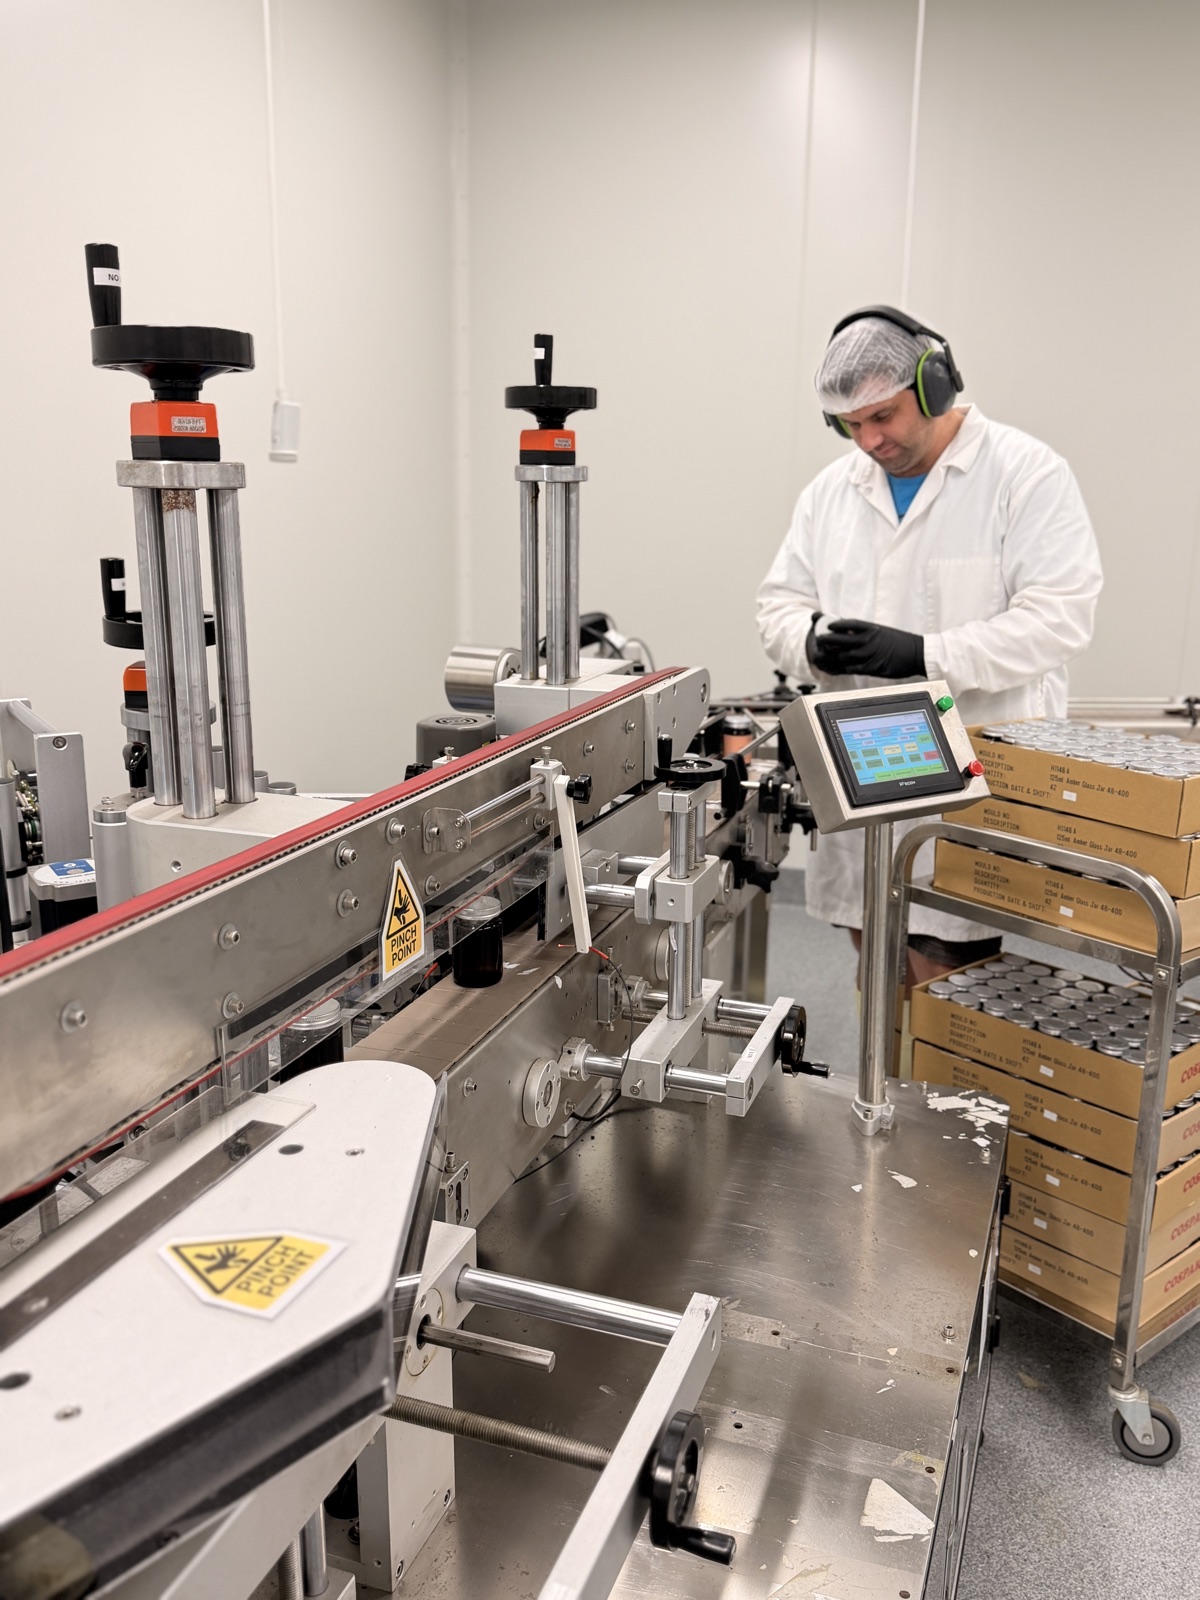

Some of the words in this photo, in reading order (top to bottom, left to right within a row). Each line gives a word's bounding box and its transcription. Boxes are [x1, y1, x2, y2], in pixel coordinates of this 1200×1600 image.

[1011, 784, 1025, 793] DATE
[1066, 778, 1080, 786] Amber
[1082, 781, 1095, 790] Glass
[1107, 787, 1129, 797] 48-400
[1089, 841, 1102, 850] Glass
[1115, 848, 1137, 858] 48-400
[1061, 893, 1074, 902] Amber
[1076, 897, 1089, 906] Glass
[1101, 904, 1122, 916] 48-400
[391, 924, 416, 952] PINCH
[392, 939, 416, 966] POINT
[236, 1244, 296, 1293] PINCH
[257, 1251, 314, 1298] POINT
